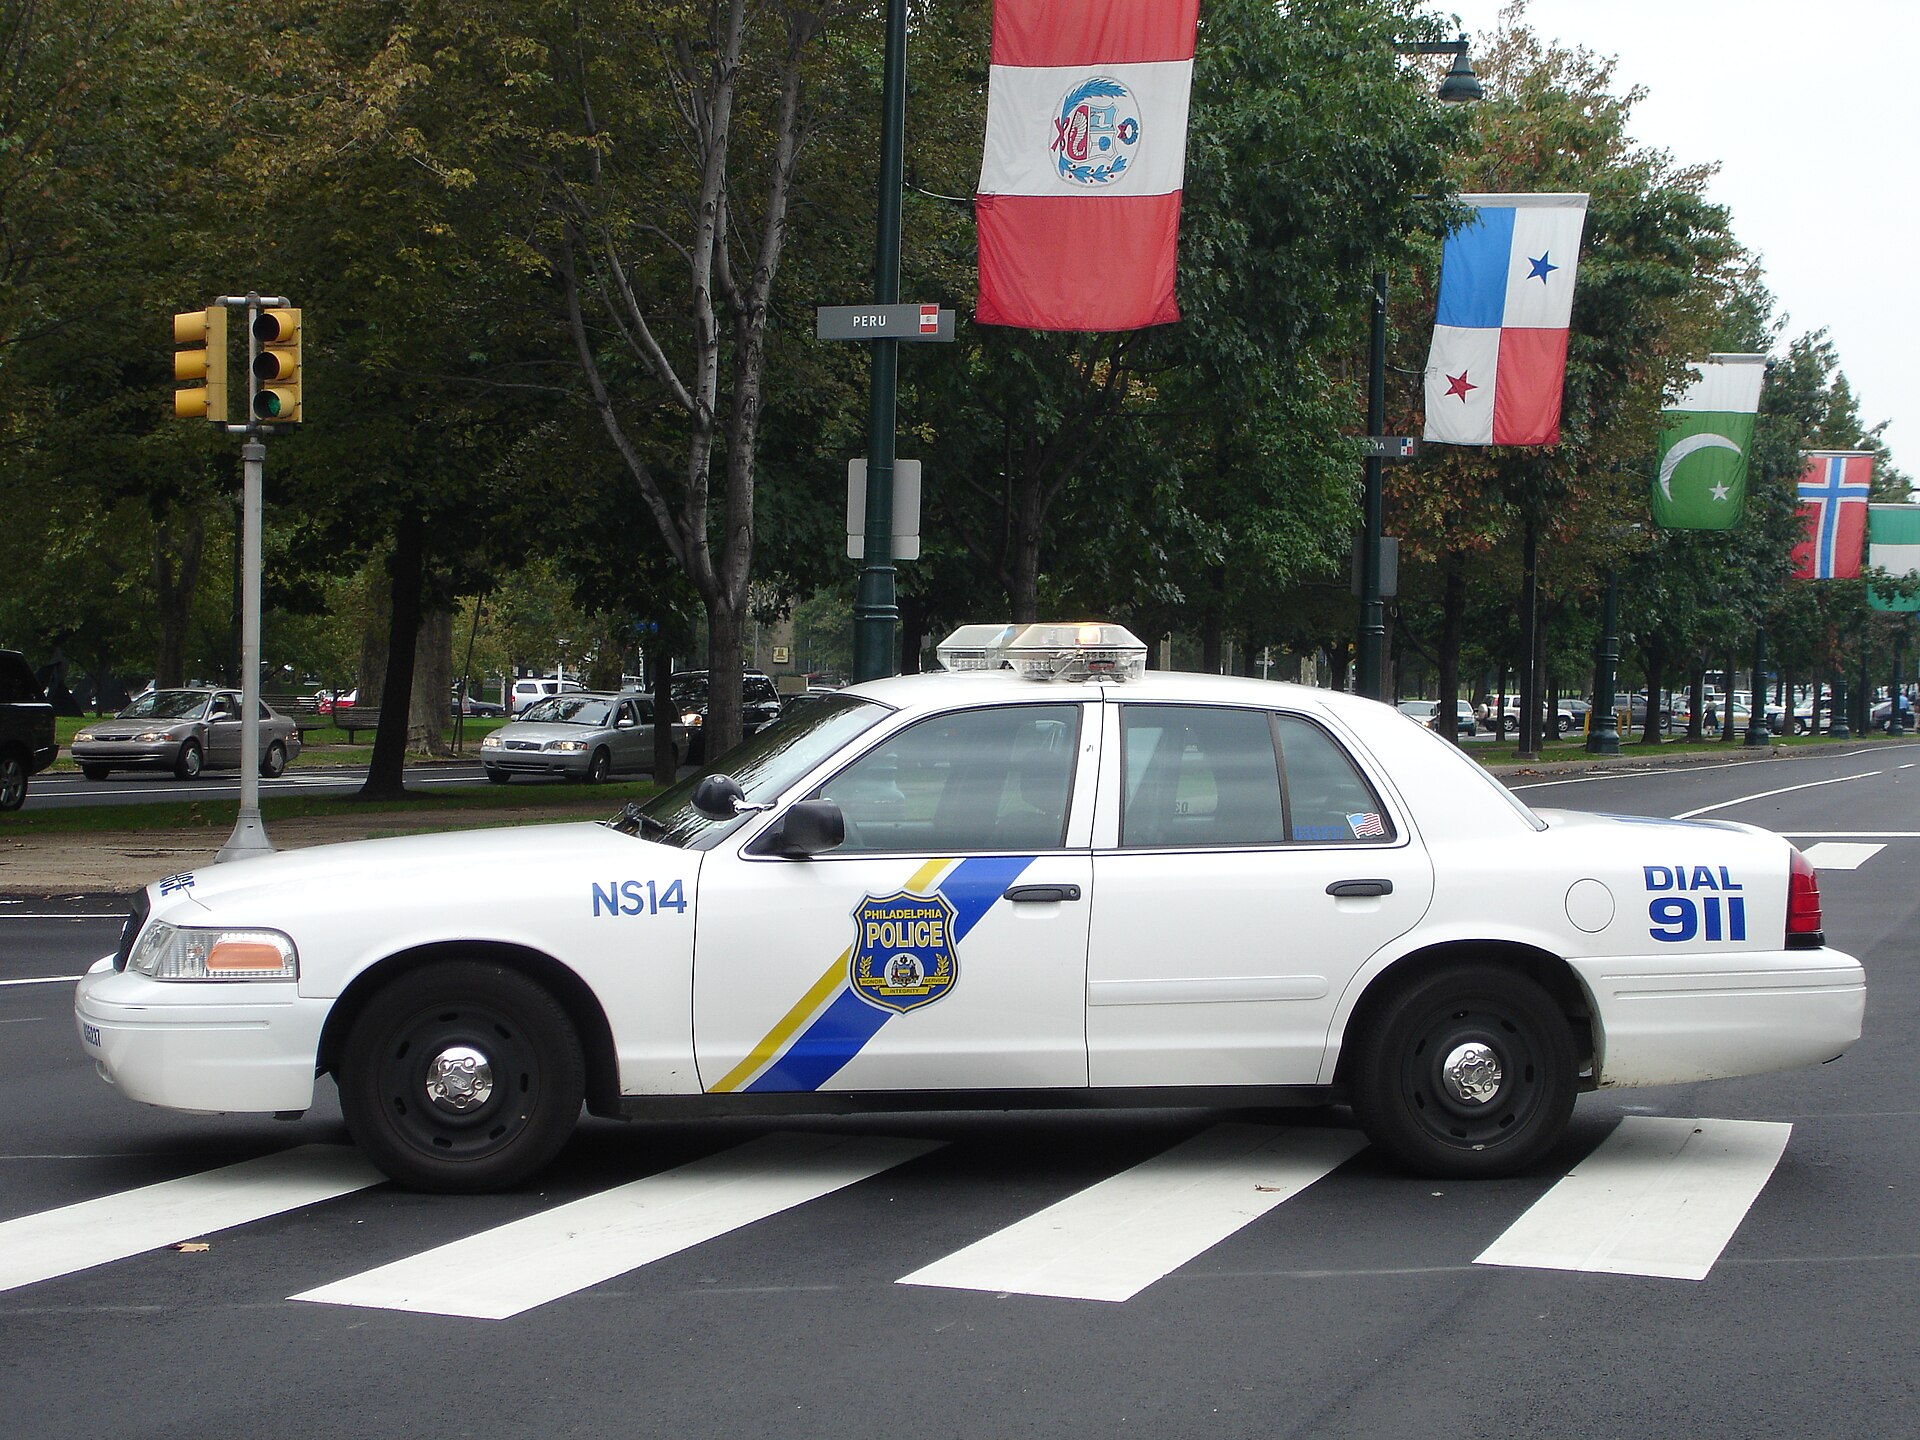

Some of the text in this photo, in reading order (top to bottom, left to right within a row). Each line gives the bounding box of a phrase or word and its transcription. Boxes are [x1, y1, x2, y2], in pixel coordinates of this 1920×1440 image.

[853, 315, 887, 327] PERU
[1643, 865, 1743, 891] DIAL
[592, 879, 688, 917] NS14
[864, 908, 943, 919] PHILADELPHIA
[1648, 896, 1746, 943] 911
[866, 920, 944, 949] POLICE
